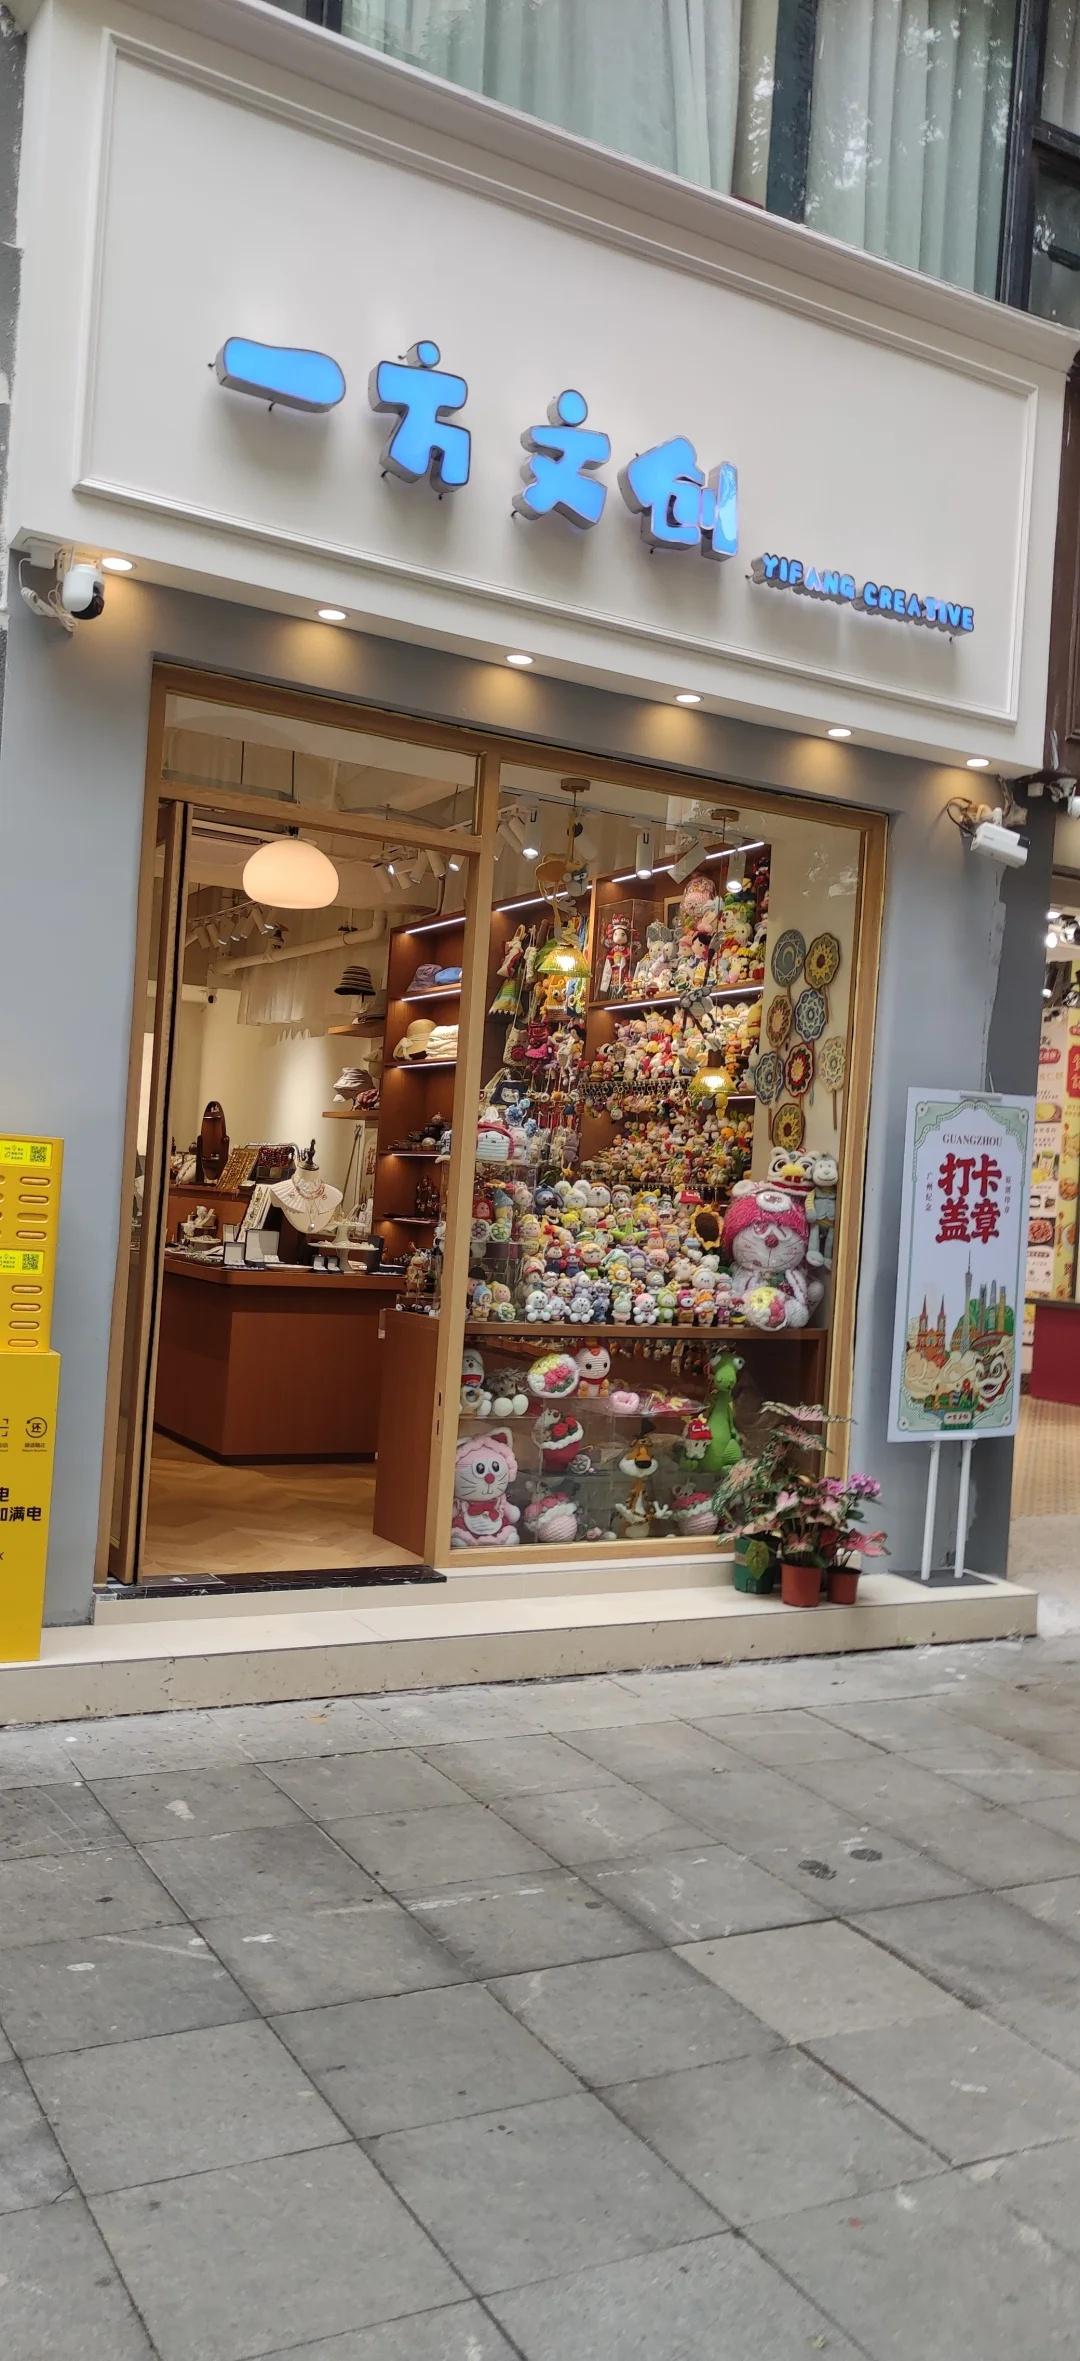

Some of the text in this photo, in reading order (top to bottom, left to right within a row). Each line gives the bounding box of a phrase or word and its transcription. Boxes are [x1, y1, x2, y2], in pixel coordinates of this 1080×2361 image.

[217, 337, 739, 560] 一方文创
[760, 553, 974, 633] YIFANG CREATIVE
[942, 1133, 1003, 1147] GUANGZHOU
[938, 1152, 1002, 1198] 打卡
[935, 1195, 1001, 1244] 盖章
